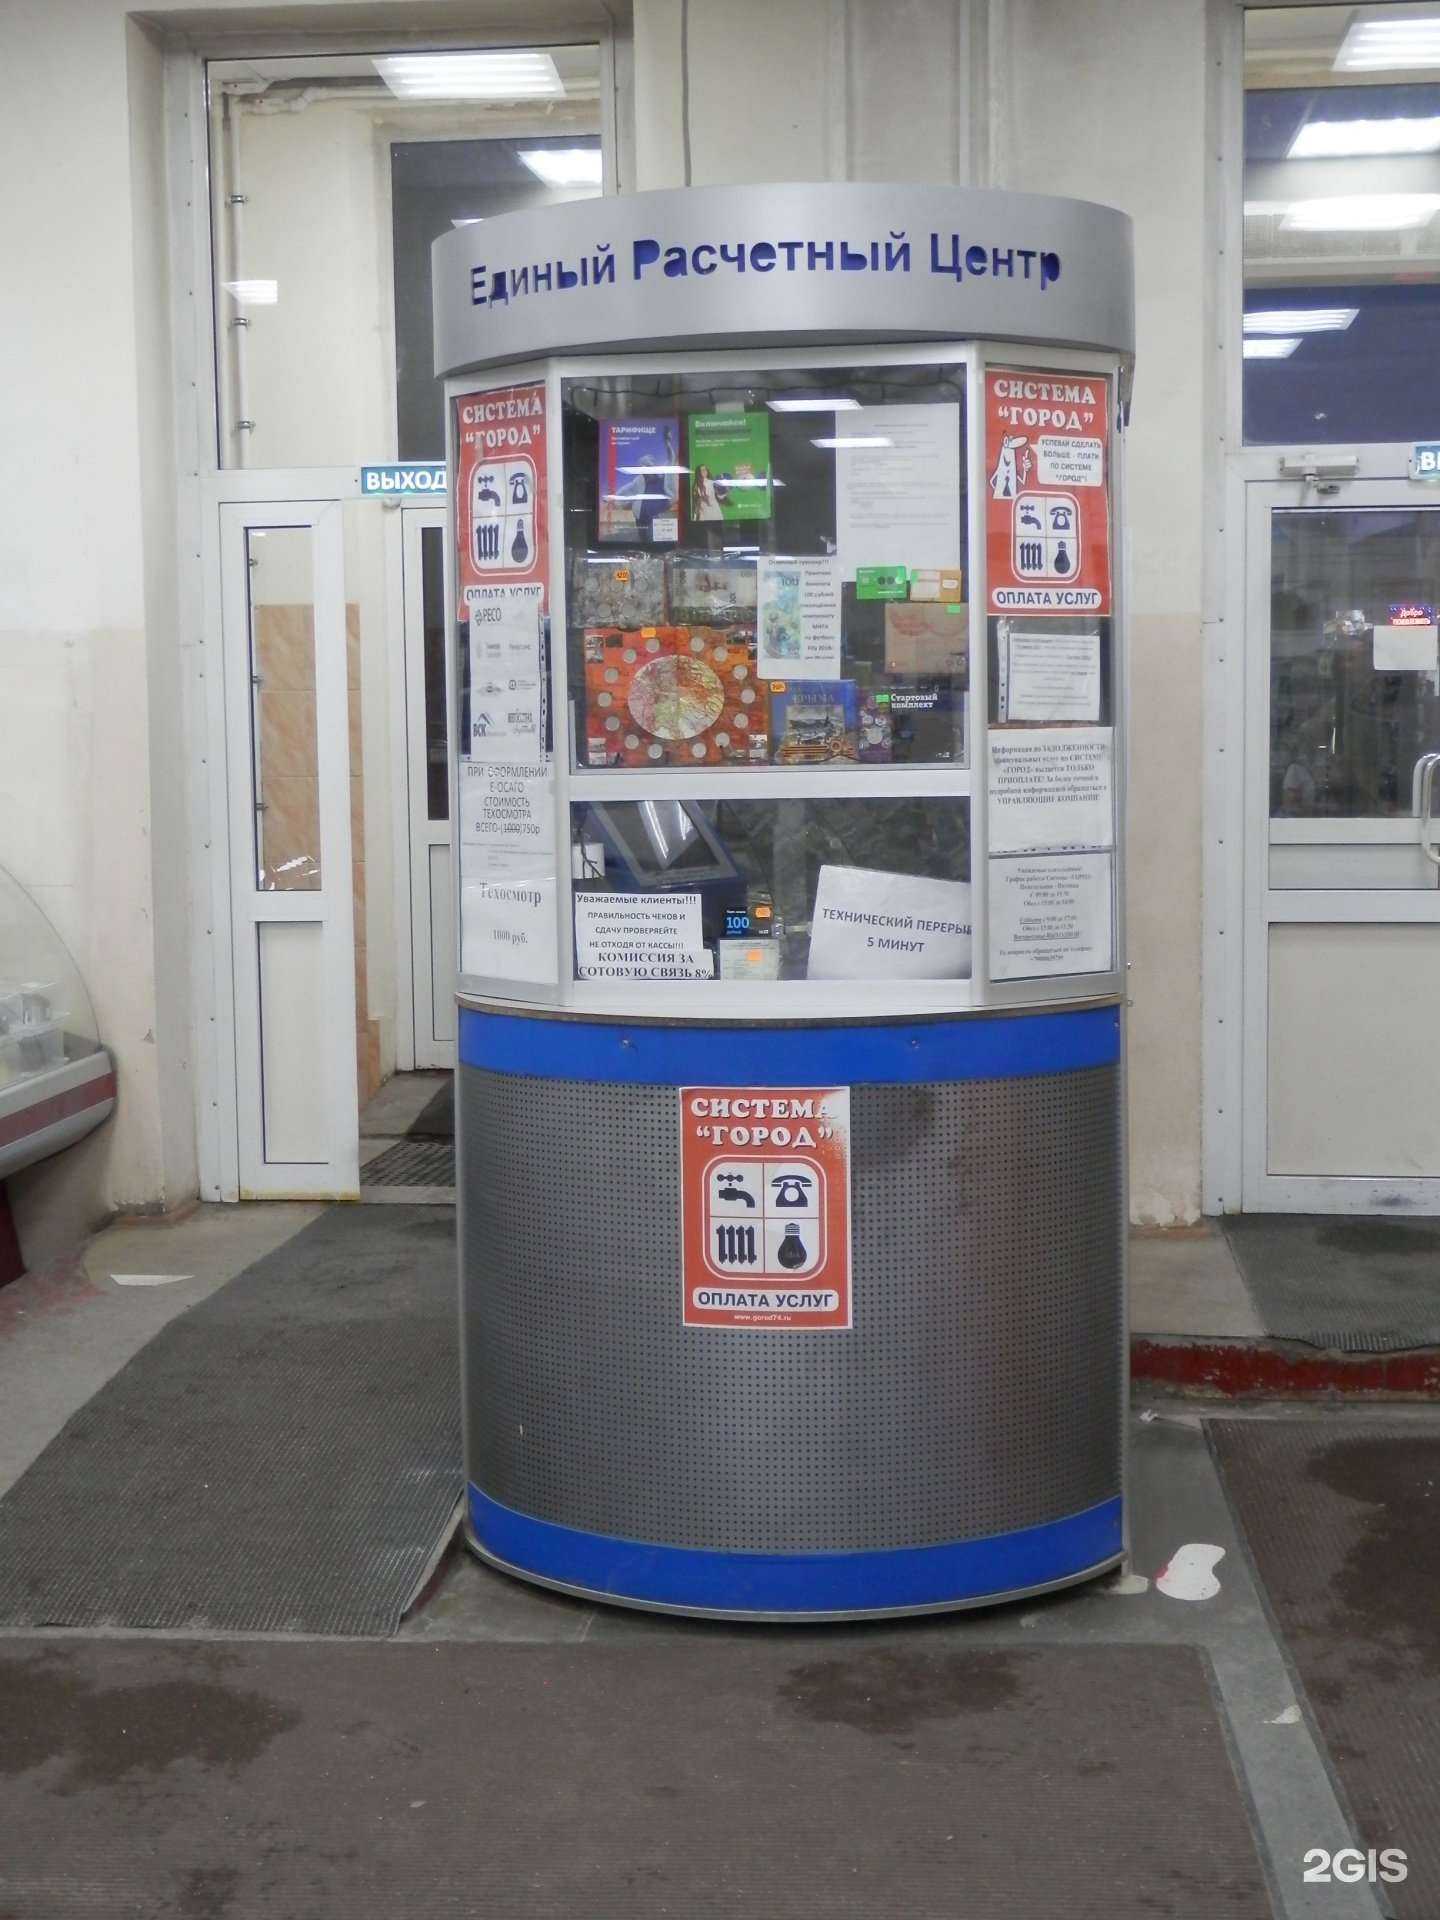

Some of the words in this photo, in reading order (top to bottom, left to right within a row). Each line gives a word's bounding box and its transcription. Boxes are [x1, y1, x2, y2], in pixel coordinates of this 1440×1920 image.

[471, 243, 616, 307] Единый
[633, 230, 911, 280] Расчетный
[929, 231, 1063, 291] Центр
[994, 380, 1096, 404] СИСТЕМА
[463, 397, 543, 424] СИСТЕМА
[998, 406, 1094, 431] “ГОРОД”
[465, 424, 541, 448] “ГОРОД”
[1421, 451, 1440, 471] В
[366, 471, 447, 490] ВЫХОД
[996, 591, 1051, 604] ОПЛАТА
[1056, 592, 1098, 605] УСЛУГ
[467, 766, 484, 777] ПРИ
[483, 796, 530, 808] СТОИМОСТЬ
[482, 808, 532, 820] ТЕХОСМОТРА
[480, 882, 542, 907] Техосмотр
[576, 894, 638, 904] Уважаемые
[641, 896, 697, 905] клиенты!!!
[588, 911, 651, 920] ПРАВИЛЬНОСТЬ
[652, 913, 678, 921] ЧЕКОВ
[679, 913, 686, 921] И
[726, 916, 750, 929] 100
[822, 907, 913, 929] ТЕХНИЧЕСКИЙ
[595, 926, 621, 934] СДАЧУ
[589, 941, 599, 949] НЕ
[601, 941, 634, 949] ОТХОДЯ
[867, 937, 874, 947] 5
[878, 938, 925, 952] МИНУТ
[598, 952, 675, 963] КОМИССИЯ
[680, 954, 694, 964] ЗА
[578, 965, 648, 977] СОТОВУЮ
[651, 966, 692, 978] СВЯЗЬ
[690, 1098, 836, 1119] СИСТЕМА
[696, 1125, 834, 1149] “ГОРОД”
[698, 1291, 770, 1307] ОПЛАТА
[775, 1294, 833, 1308] УСЛУГ
